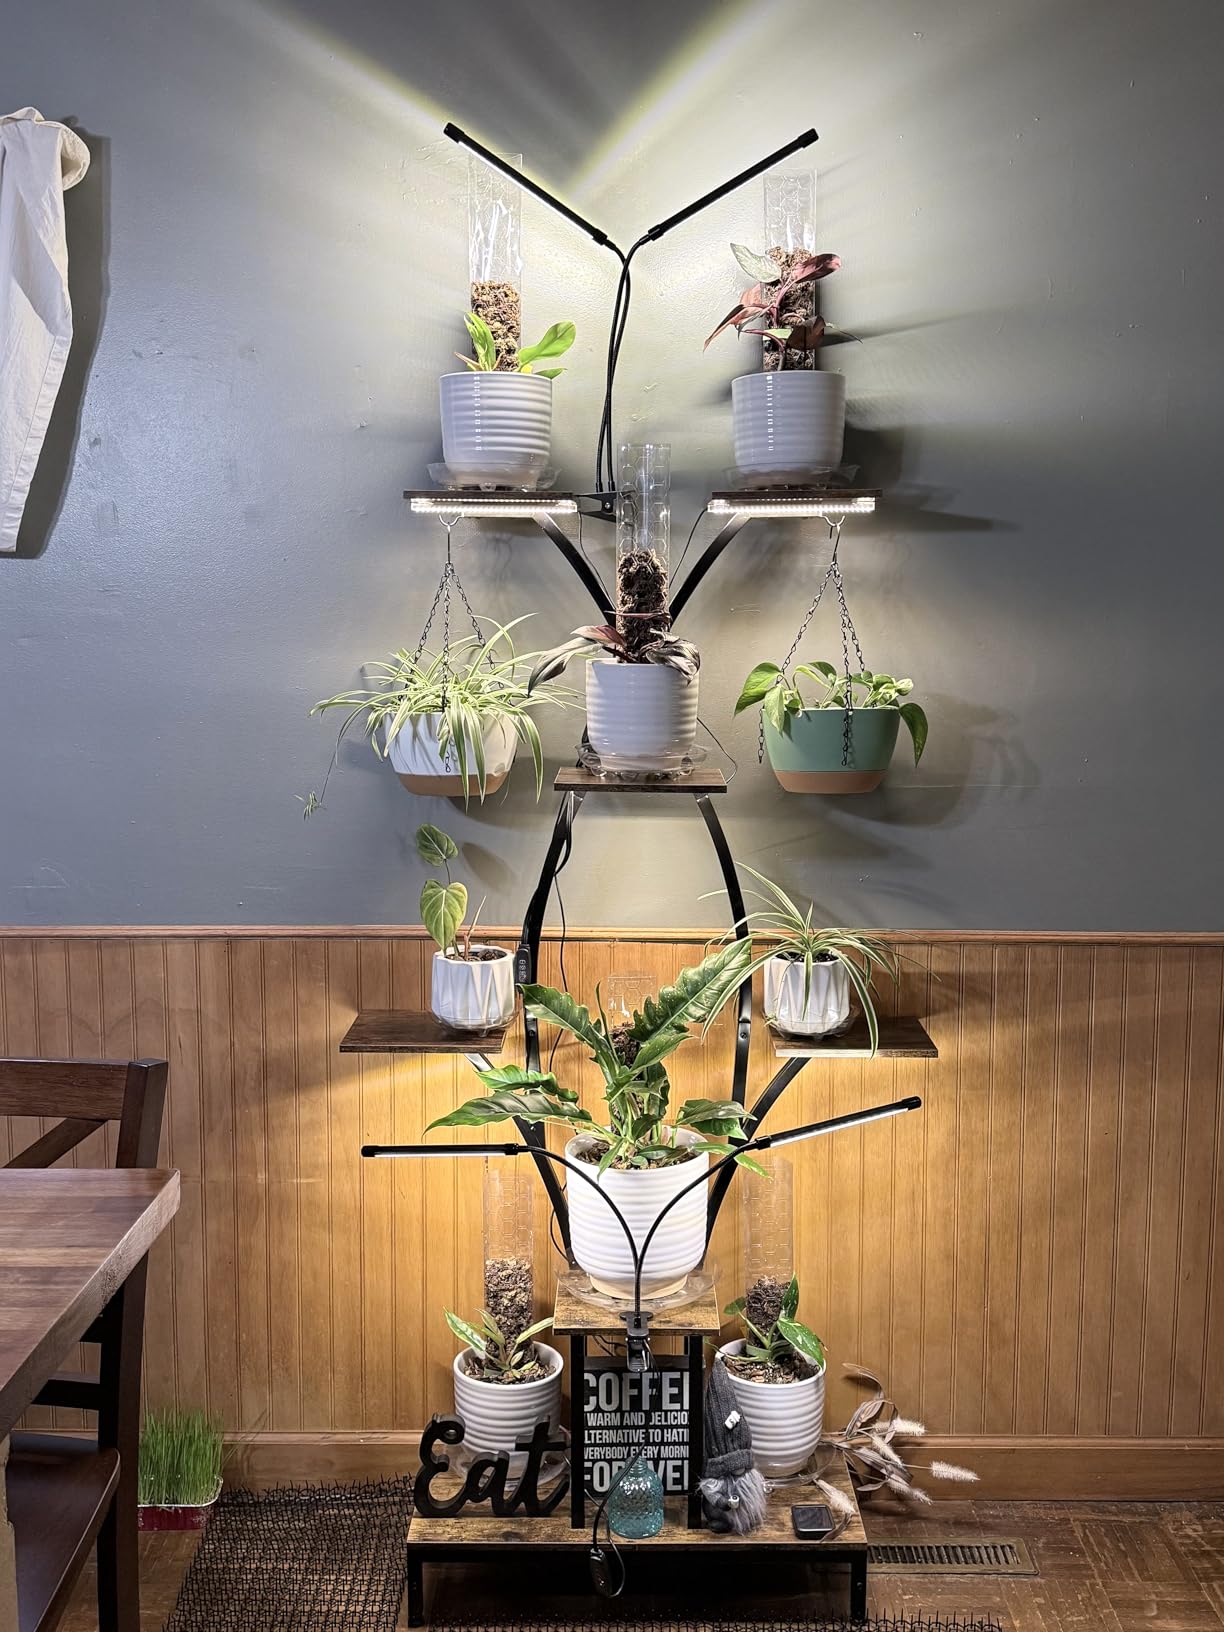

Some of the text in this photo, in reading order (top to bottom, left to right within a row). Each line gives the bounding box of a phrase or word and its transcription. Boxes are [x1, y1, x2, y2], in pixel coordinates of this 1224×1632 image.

[587, 1411, 689, 1426] WARM AND ELICIO
[584, 1429, 646, 1443] LTERNATIVE
[648, 1429, 661, 1442] TO
[414, 1413, 571, 1517] Eat
